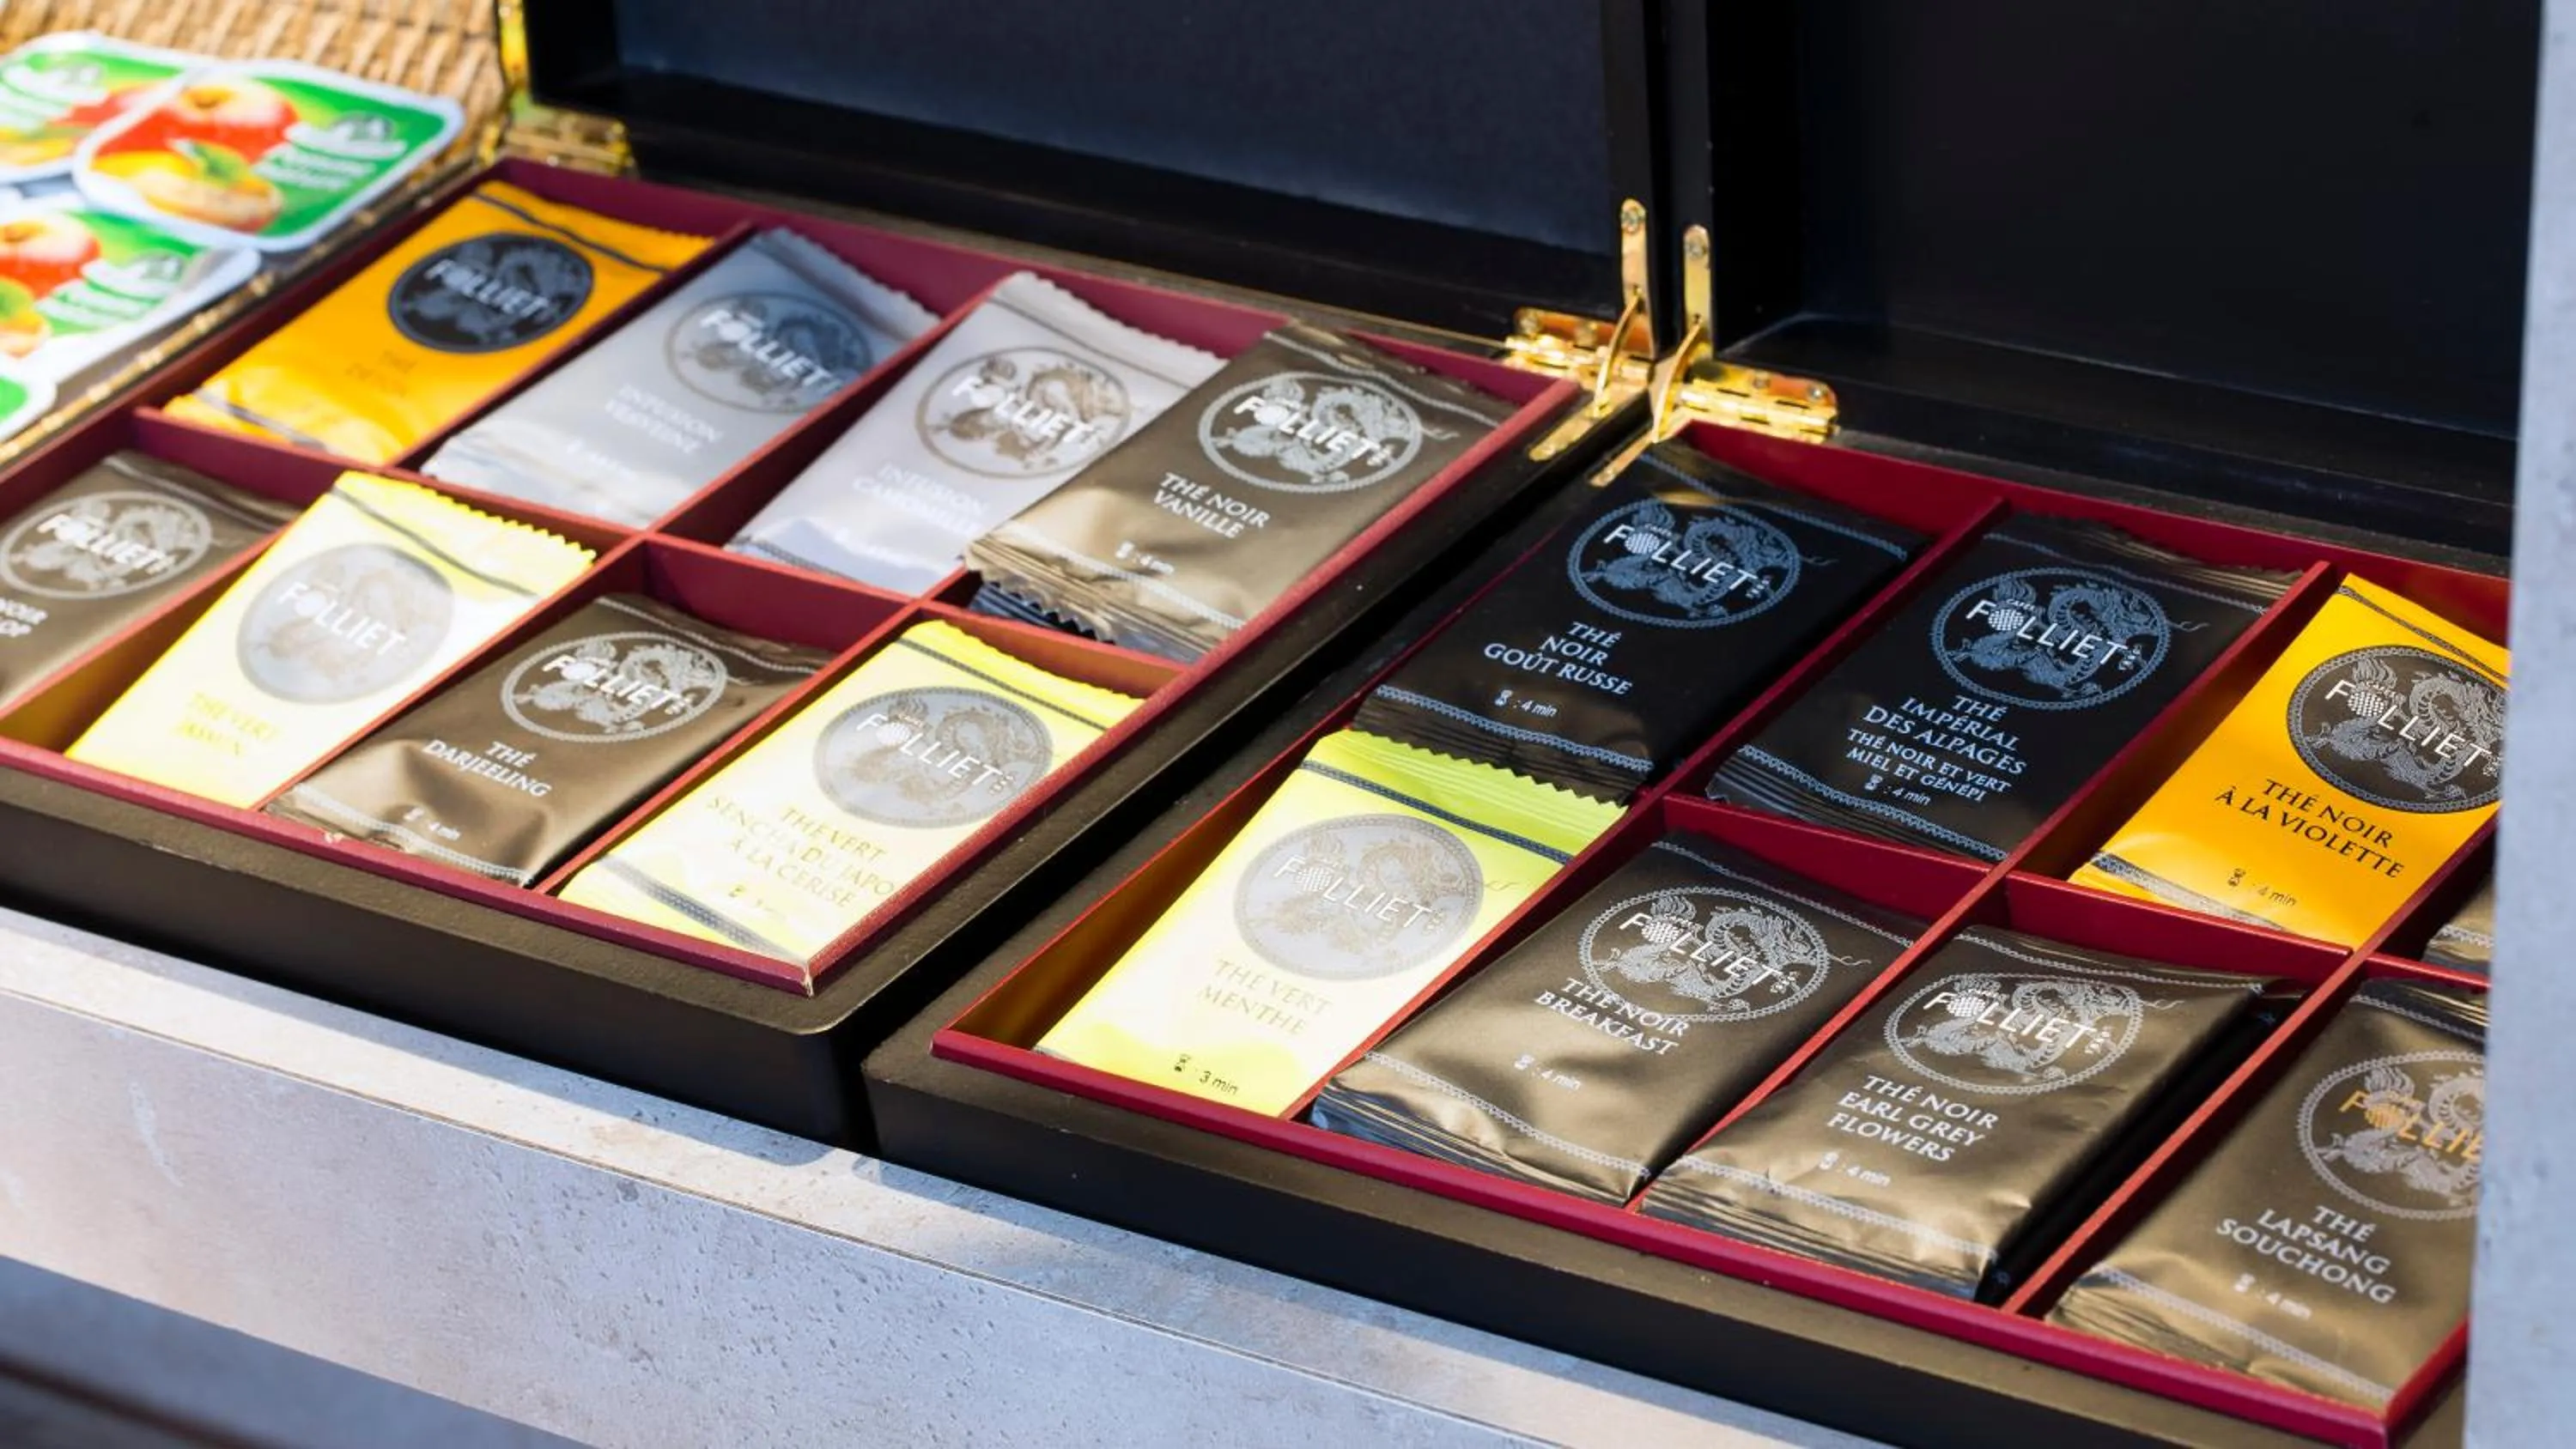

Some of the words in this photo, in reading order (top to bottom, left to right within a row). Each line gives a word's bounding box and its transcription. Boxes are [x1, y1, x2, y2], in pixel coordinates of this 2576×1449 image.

[700, 309, 833, 388] FOLLIET
[951, 375, 1095, 445] FOLLIET
[1233, 396, 1381, 460] FOLLIET
[1153, 489, 1245, 539] VANILLE
[1206, 492, 1270, 529] NOIR
[36, 513, 167, 570] FOLLIET
[1603, 523, 1759, 591] FOLLIET
[276, 581, 407, 656] FOLLIET
[1568, 621, 1623, 649] THÉ
[1965, 599, 2128, 666] FOLLIET
[1483, 641, 1559, 674] GOÛT
[1557, 661, 1633, 697] RUSSE
[1539, 635, 1609, 667] NOIR
[542, 653, 686, 712] FOLLIET
[1521, 700, 1534, 712] 4
[1531, 704, 1558, 718] min
[1952, 694, 2008, 724] THÉ
[856, 712, 1004, 787] FOLLIET
[1863, 705, 1917, 736] DES
[1913, 724, 2027, 777] ALPAGES
[1899, 695, 2020, 752] IMPÉRIAL
[2324, 679, 2492, 767] FOLLIET
[422, 739, 553, 797] DARJEELING
[486, 742, 538, 767] THÉ
[1846, 747, 1890, 773] MIEL
[1893, 761, 1920, 782] ET
[1920, 771, 1989, 803] GÉNÉPI
[1847, 727, 1884, 749] THÉ
[1886, 741, 1935, 771] NOIR
[1937, 758, 1962, 779] ET
[1965, 771, 2012, 795] VERT
[1893, 787, 1905, 797] 4
[1905, 791, 1931, 805] min
[2261, 779, 2321, 812] THÉ
[2316, 803, 2394, 849] NOIR
[829, 830, 887, 864] VERT
[2215, 785, 2234, 808] À
[2239, 797, 2269, 822] LA
[2281, 812, 2405, 879] VIOLETTE
[776, 864, 856, 907] CERISE
[837, 863, 896, 895] JAPO
[1273, 854, 1431, 928] FOLLIET
[2269, 892, 2297, 906] min
[1619, 912, 1783, 987] FOLLIET
[1195, 985, 1306, 1034] MENTHE
[1270, 980, 1334, 1015] VERT
[1534, 990, 1680, 1056] BREAKFAST
[1618, 1005, 1691, 1038] NOIR
[1923, 991, 2097, 1050] FOLLIET
[1199, 1070, 1212, 1083] 3
[1212, 1077, 1238, 1094] min
[1863, 1075, 1923, 1104] THÉ
[1920, 1092, 1999, 1130] NOIR
[1827, 1113, 1956, 1162] FLOWERS
[1838, 1092, 1903, 1122] EARL
[1909, 1113, 1986, 1148] GREY
[2338, 1090, 2482, 1160] FOLLIE
[2257, 1209, 2391, 1274] LAPSANG
[2312, 1205, 2377, 1242] THÉ
[2216, 1218, 2397, 1304] SOUCHONG
